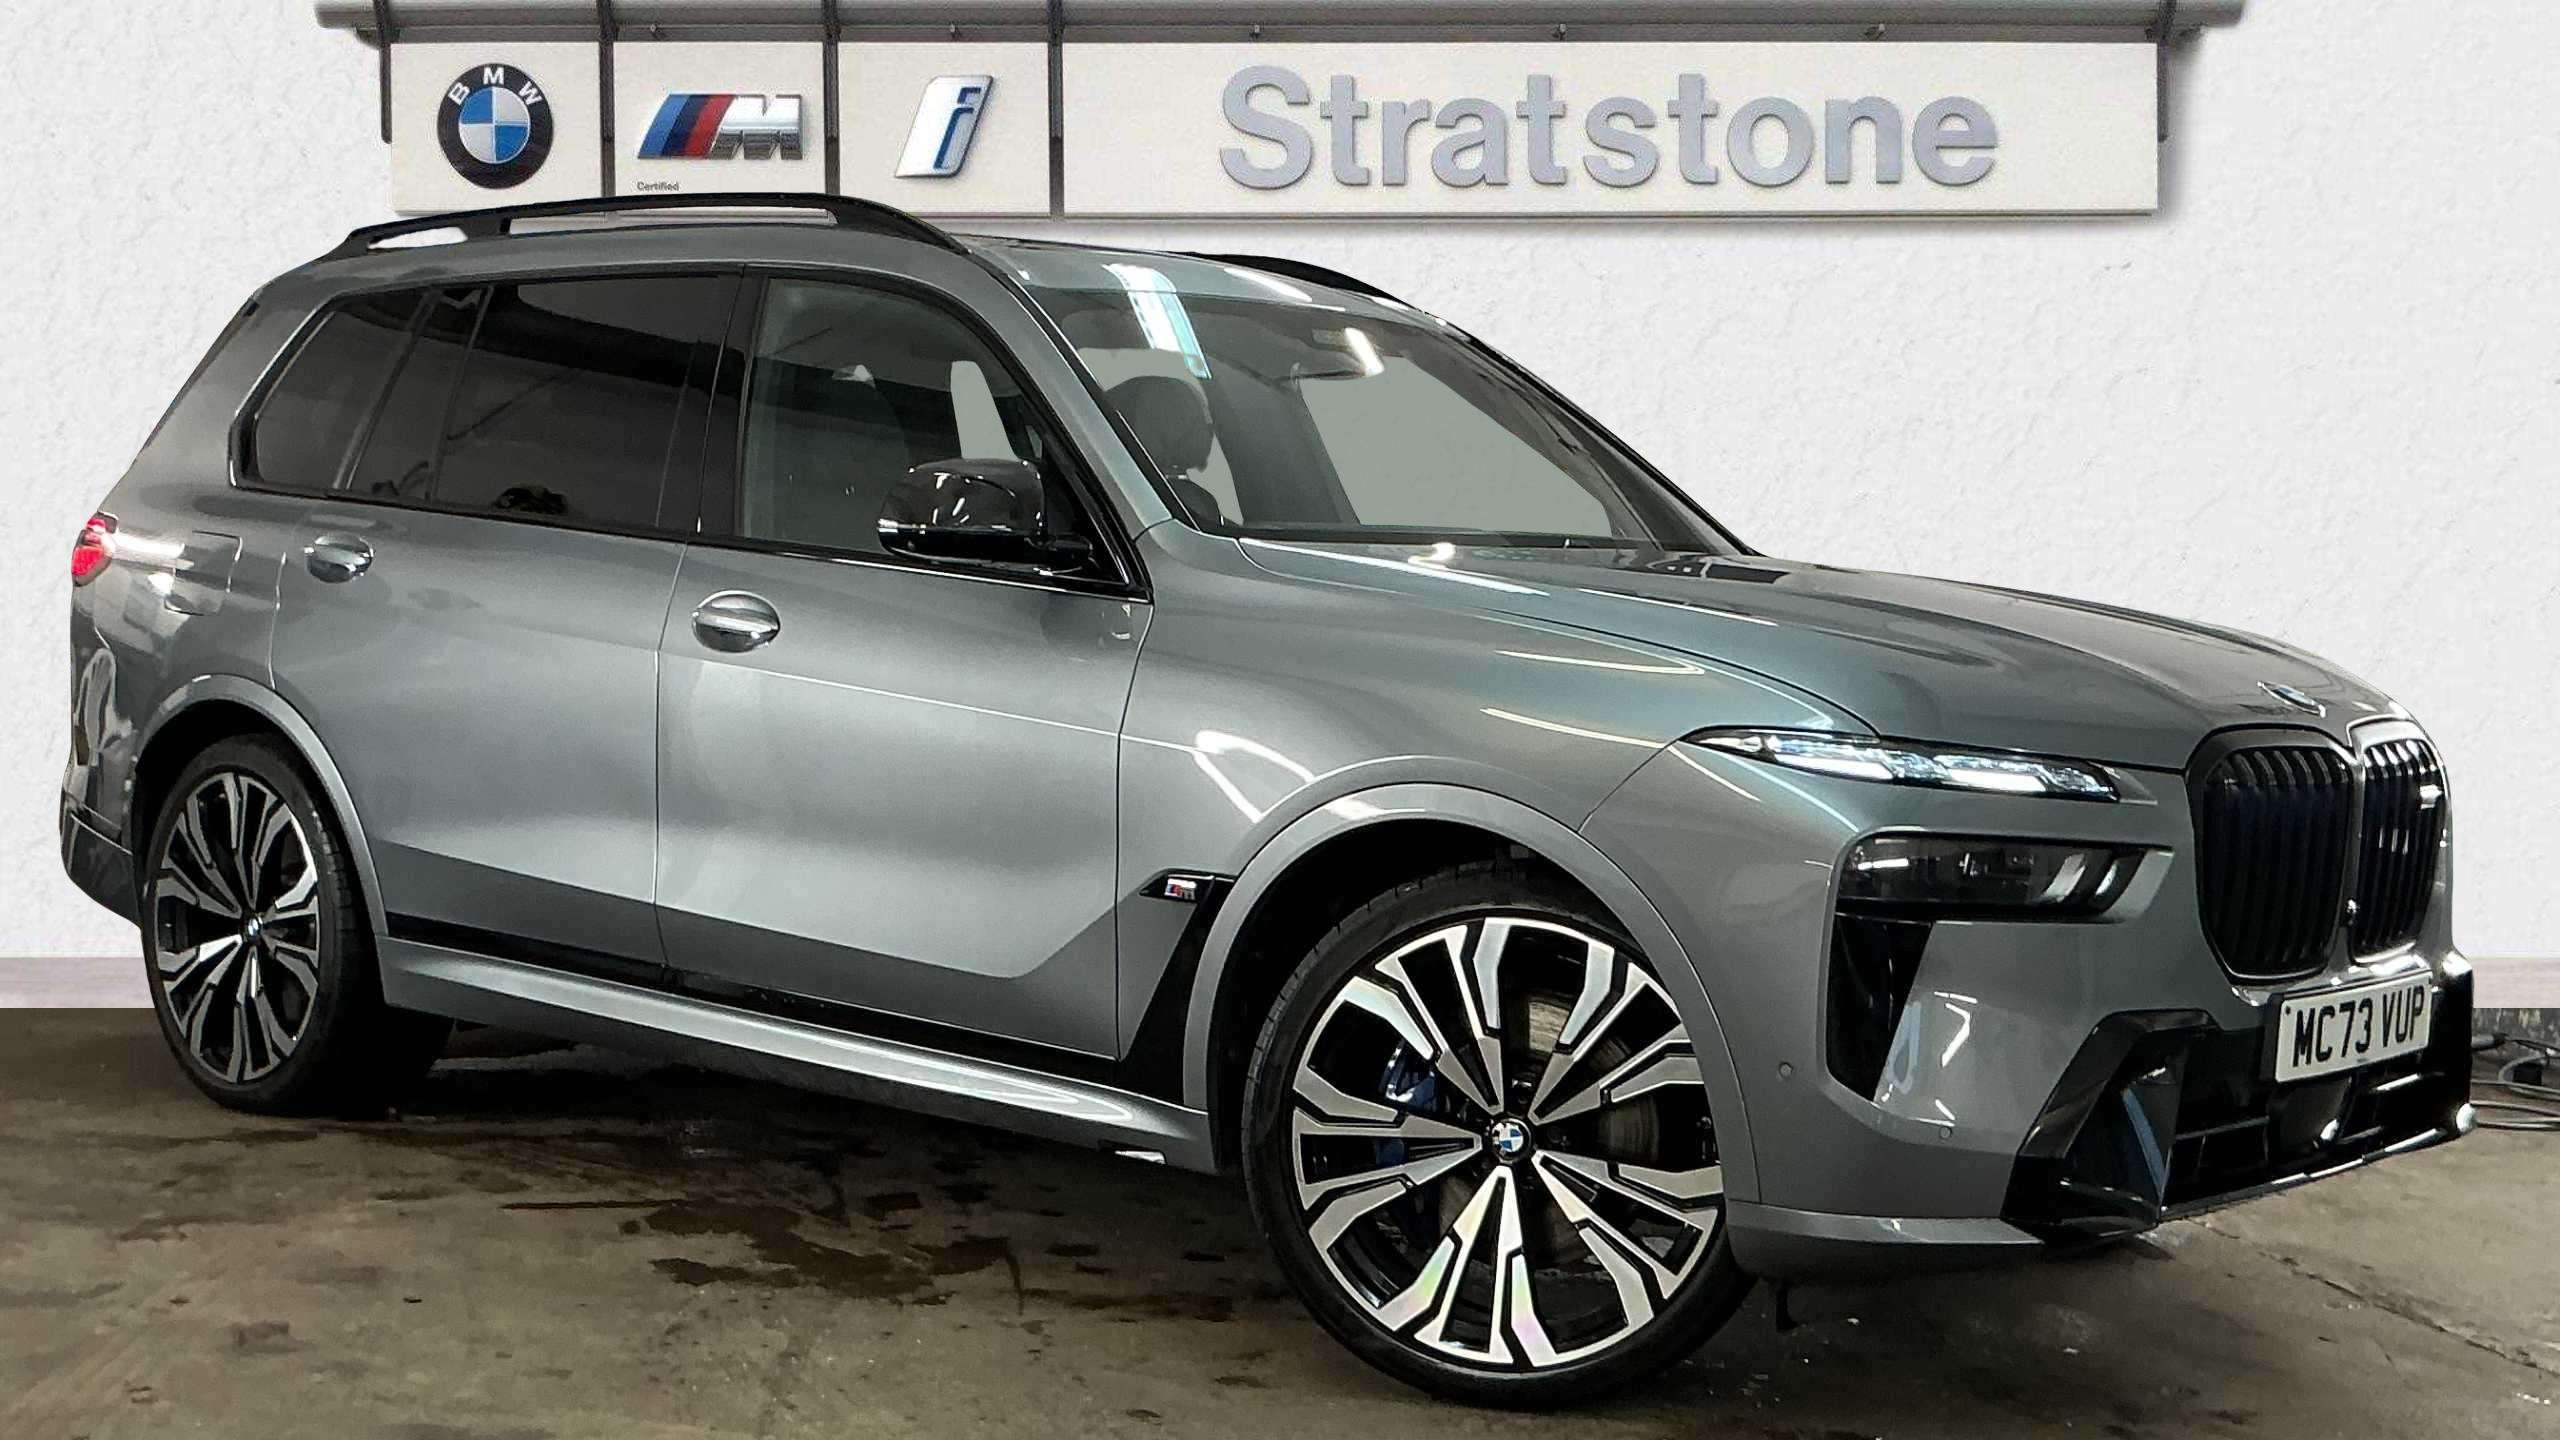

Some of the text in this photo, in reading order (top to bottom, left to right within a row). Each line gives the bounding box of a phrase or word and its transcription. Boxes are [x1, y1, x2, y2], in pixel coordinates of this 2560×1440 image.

[447, 66, 543, 106] BMW
[1219, 64, 1999, 189] Stratstone
[636, 181, 680, 192] Certified
[2292, 984, 2425, 1068] MC73 VUP
